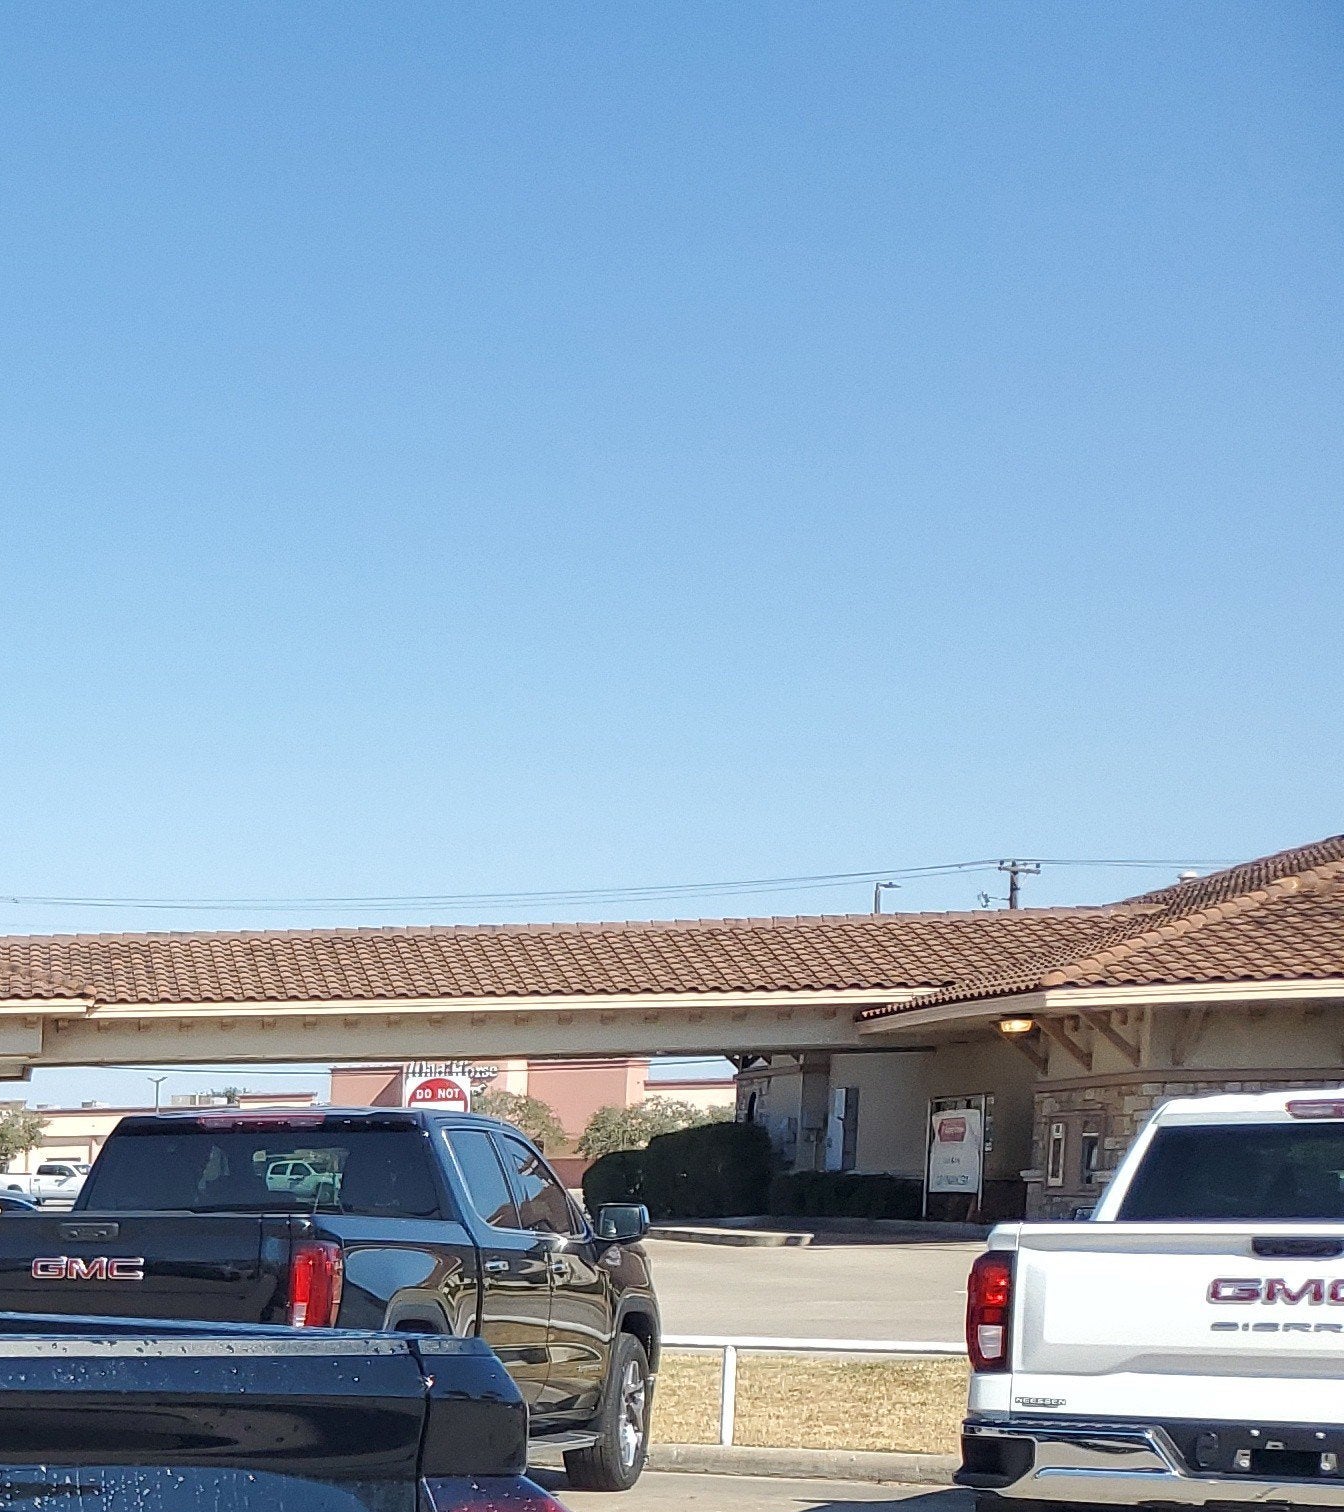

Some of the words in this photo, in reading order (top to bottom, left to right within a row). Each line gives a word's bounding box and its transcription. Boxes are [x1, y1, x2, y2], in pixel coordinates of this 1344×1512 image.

[416, 1089, 432, 1099] DO
[437, 1088, 460, 1099] NOT
[31, 1256, 145, 1281] GMC
